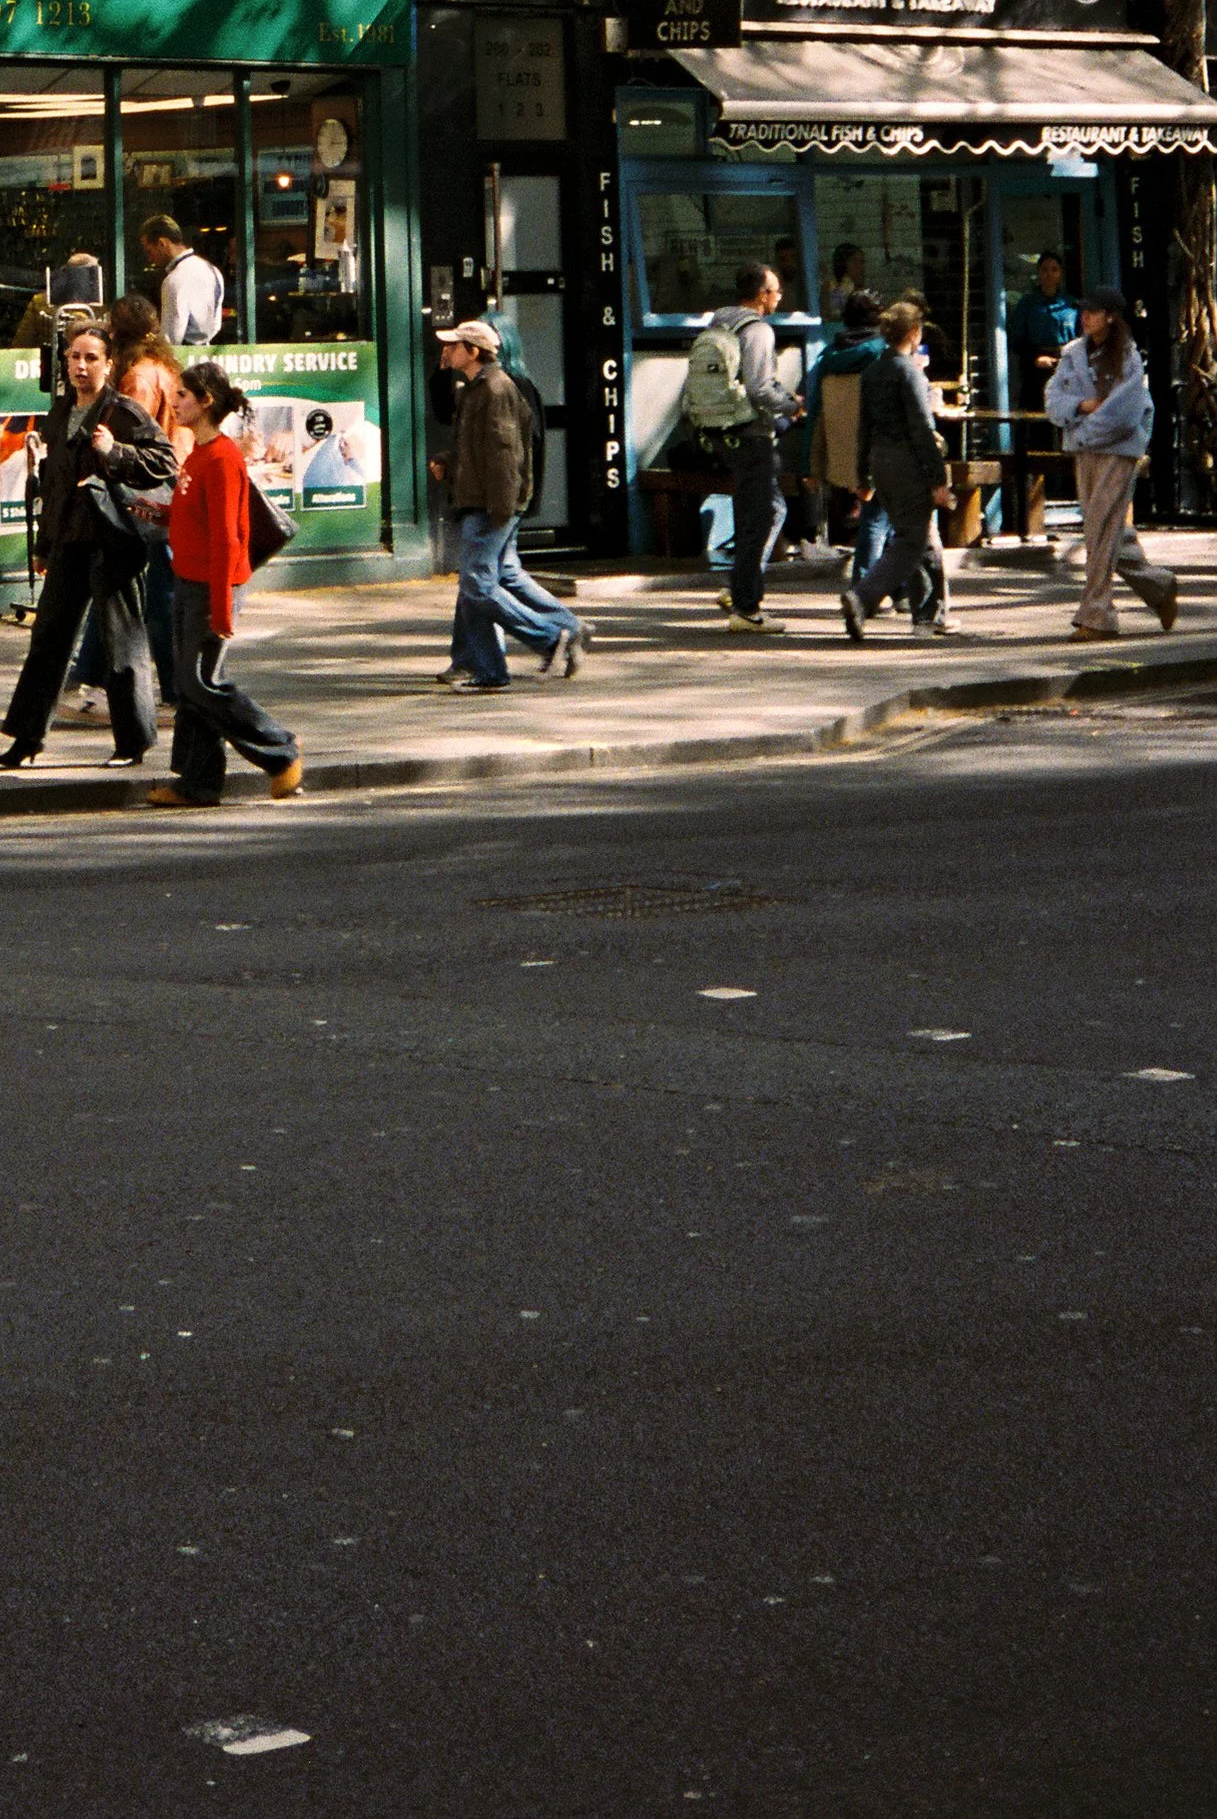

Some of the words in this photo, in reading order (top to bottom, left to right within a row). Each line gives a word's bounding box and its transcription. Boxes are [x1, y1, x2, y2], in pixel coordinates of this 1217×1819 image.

[656, 20, 712, 42] CHIPS
[730, 123, 828, 141] TRADITIONAL
[831, 125, 864, 142] FISH
[880, 125, 924, 143] CHIPS
[1041, 125, 1126, 143] RESTAURANT
[1141, 126, 1209, 143] TAKEAWAY
[600, 172, 615, 272] FISH
[602, 305, 616, 326] &
[15, 359, 41, 379] DR
[282, 351, 358, 372] SERVICE
[602, 359, 621, 489] CHIPS
